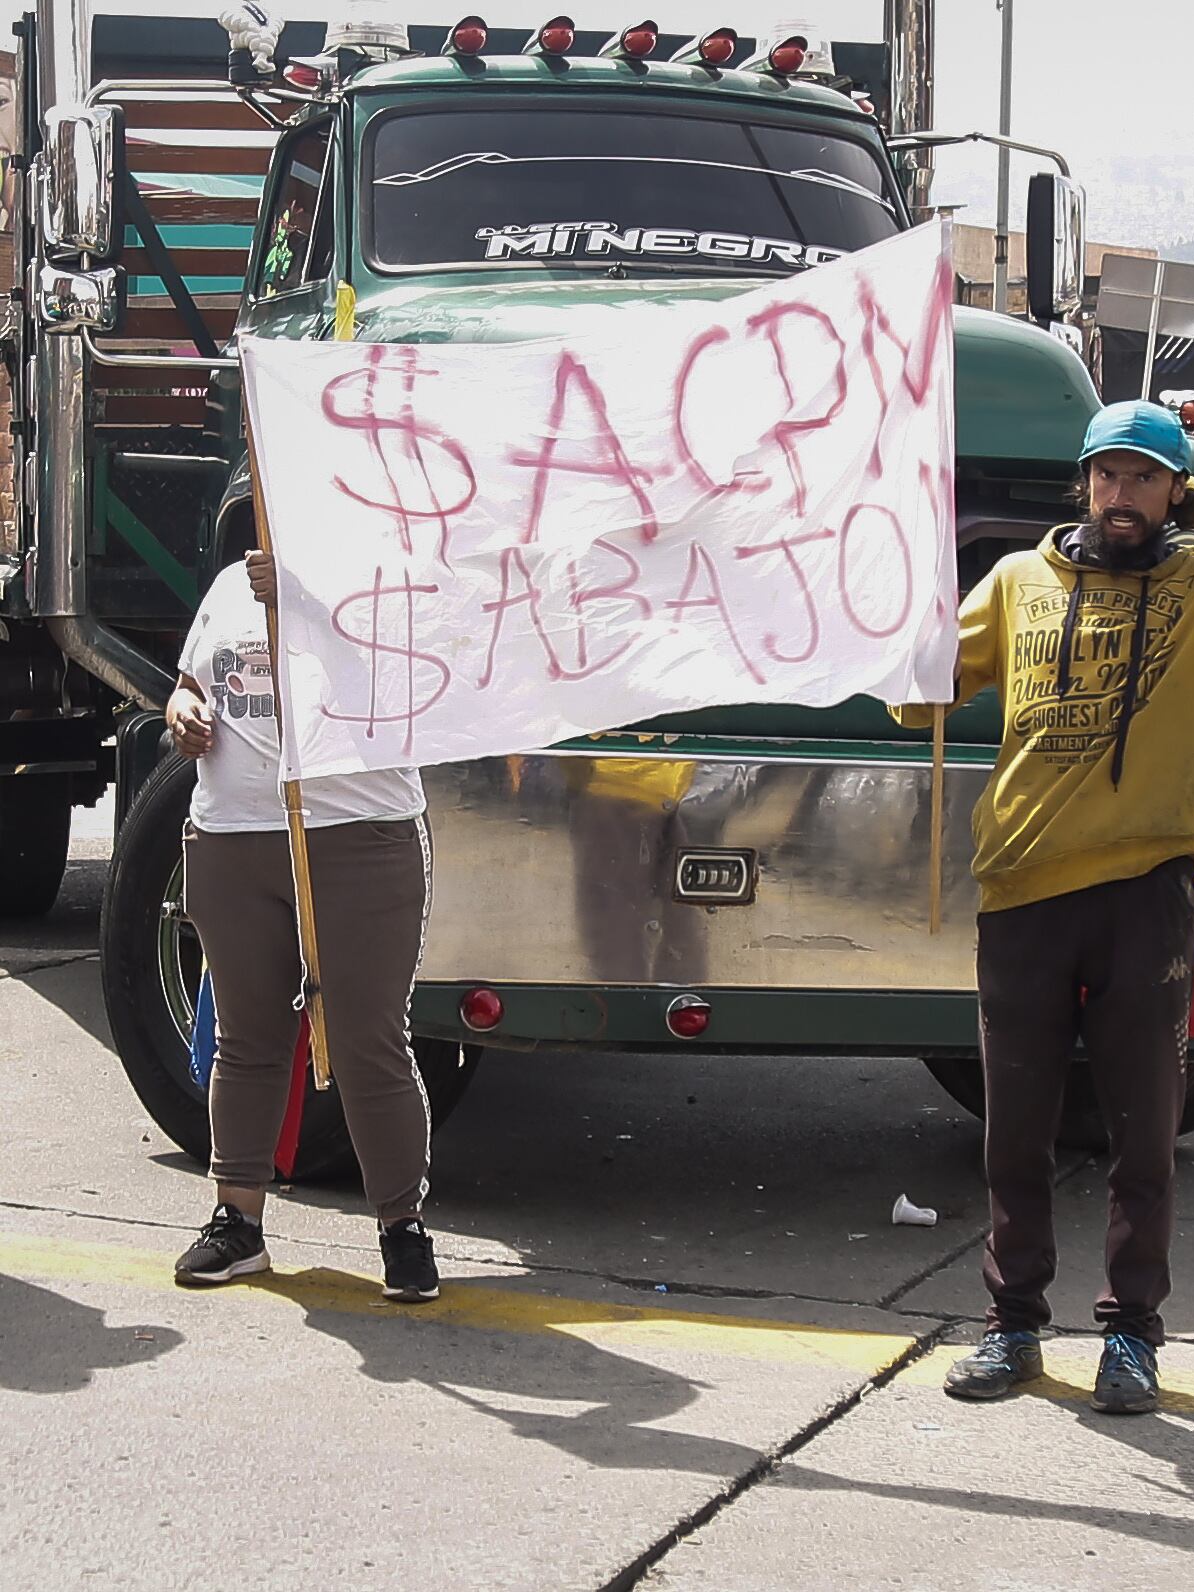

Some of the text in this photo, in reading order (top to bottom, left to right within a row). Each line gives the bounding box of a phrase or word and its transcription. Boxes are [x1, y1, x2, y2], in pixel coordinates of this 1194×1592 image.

[485, 231, 577, 259] MI
[1014, 629, 1121, 674] BROOLYN
[1033, 702, 1102, 729] HIGHEST
